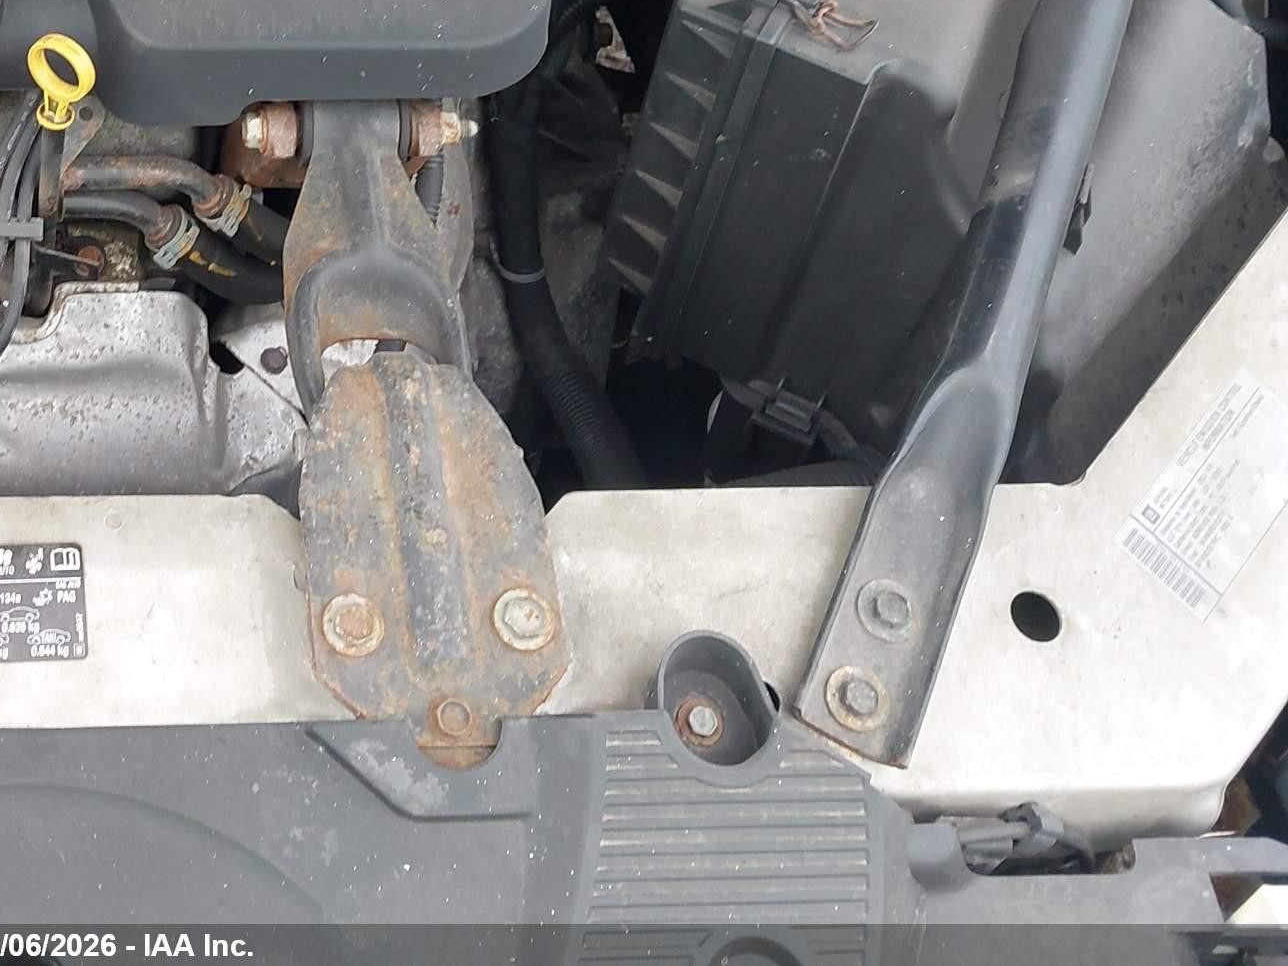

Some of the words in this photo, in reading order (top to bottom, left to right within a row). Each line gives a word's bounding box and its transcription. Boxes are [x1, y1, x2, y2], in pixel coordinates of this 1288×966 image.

[57, 590, 77, 603] PAG
[27, 618, 41, 635] kg
[57, 643, 70, 659] kg
